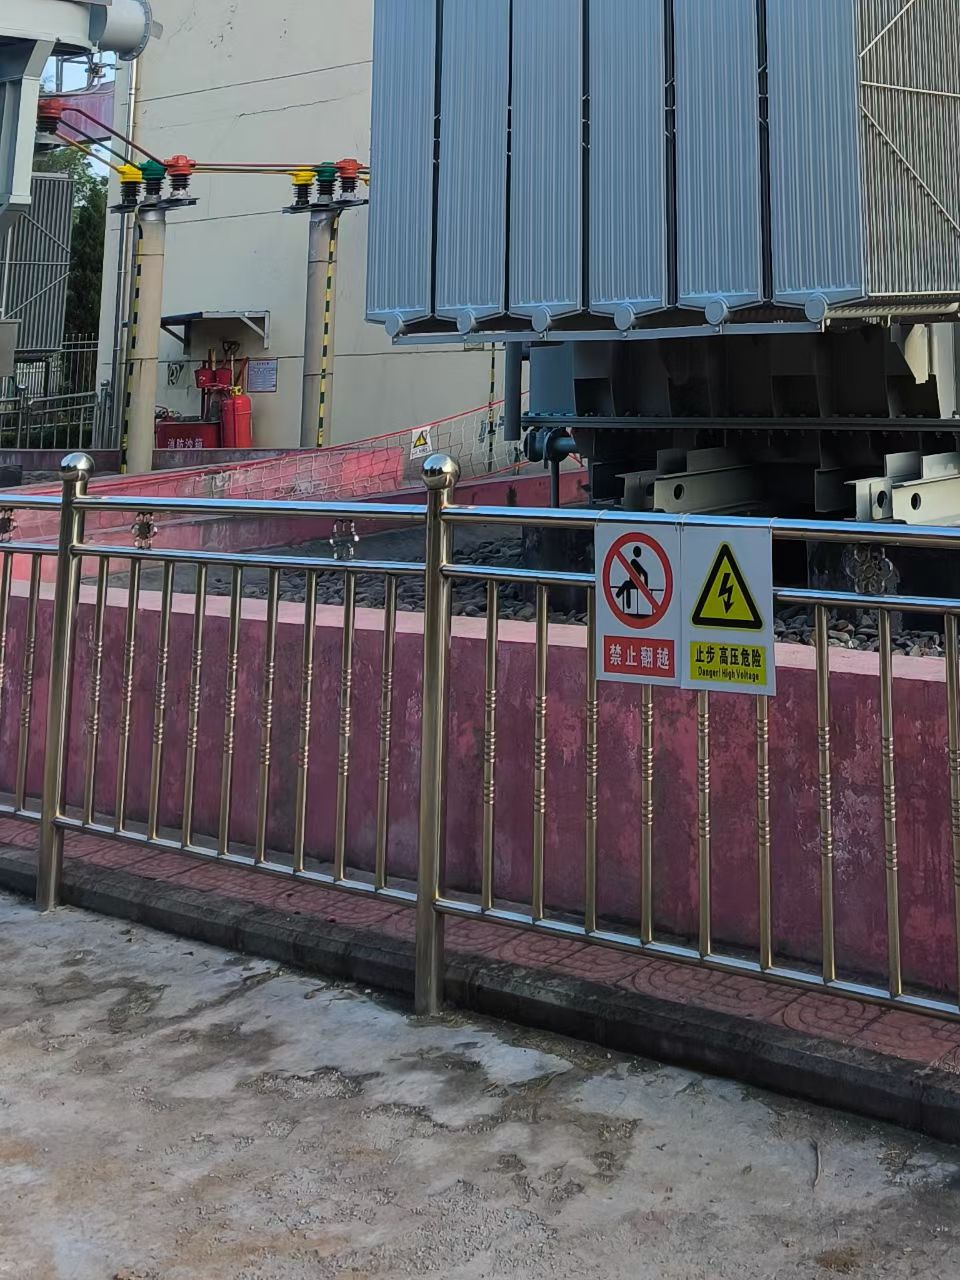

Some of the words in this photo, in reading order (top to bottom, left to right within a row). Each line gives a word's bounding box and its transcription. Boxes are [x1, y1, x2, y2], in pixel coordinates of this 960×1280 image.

[609, 643, 669, 670] 禁止翻越
[695, 645, 716, 664] 止步
[719, 646, 762, 668] 高压危险
[697, 666, 721, 679] Danger!
[722, 668, 736, 680] High
[736, 669, 760, 682] Voltage
